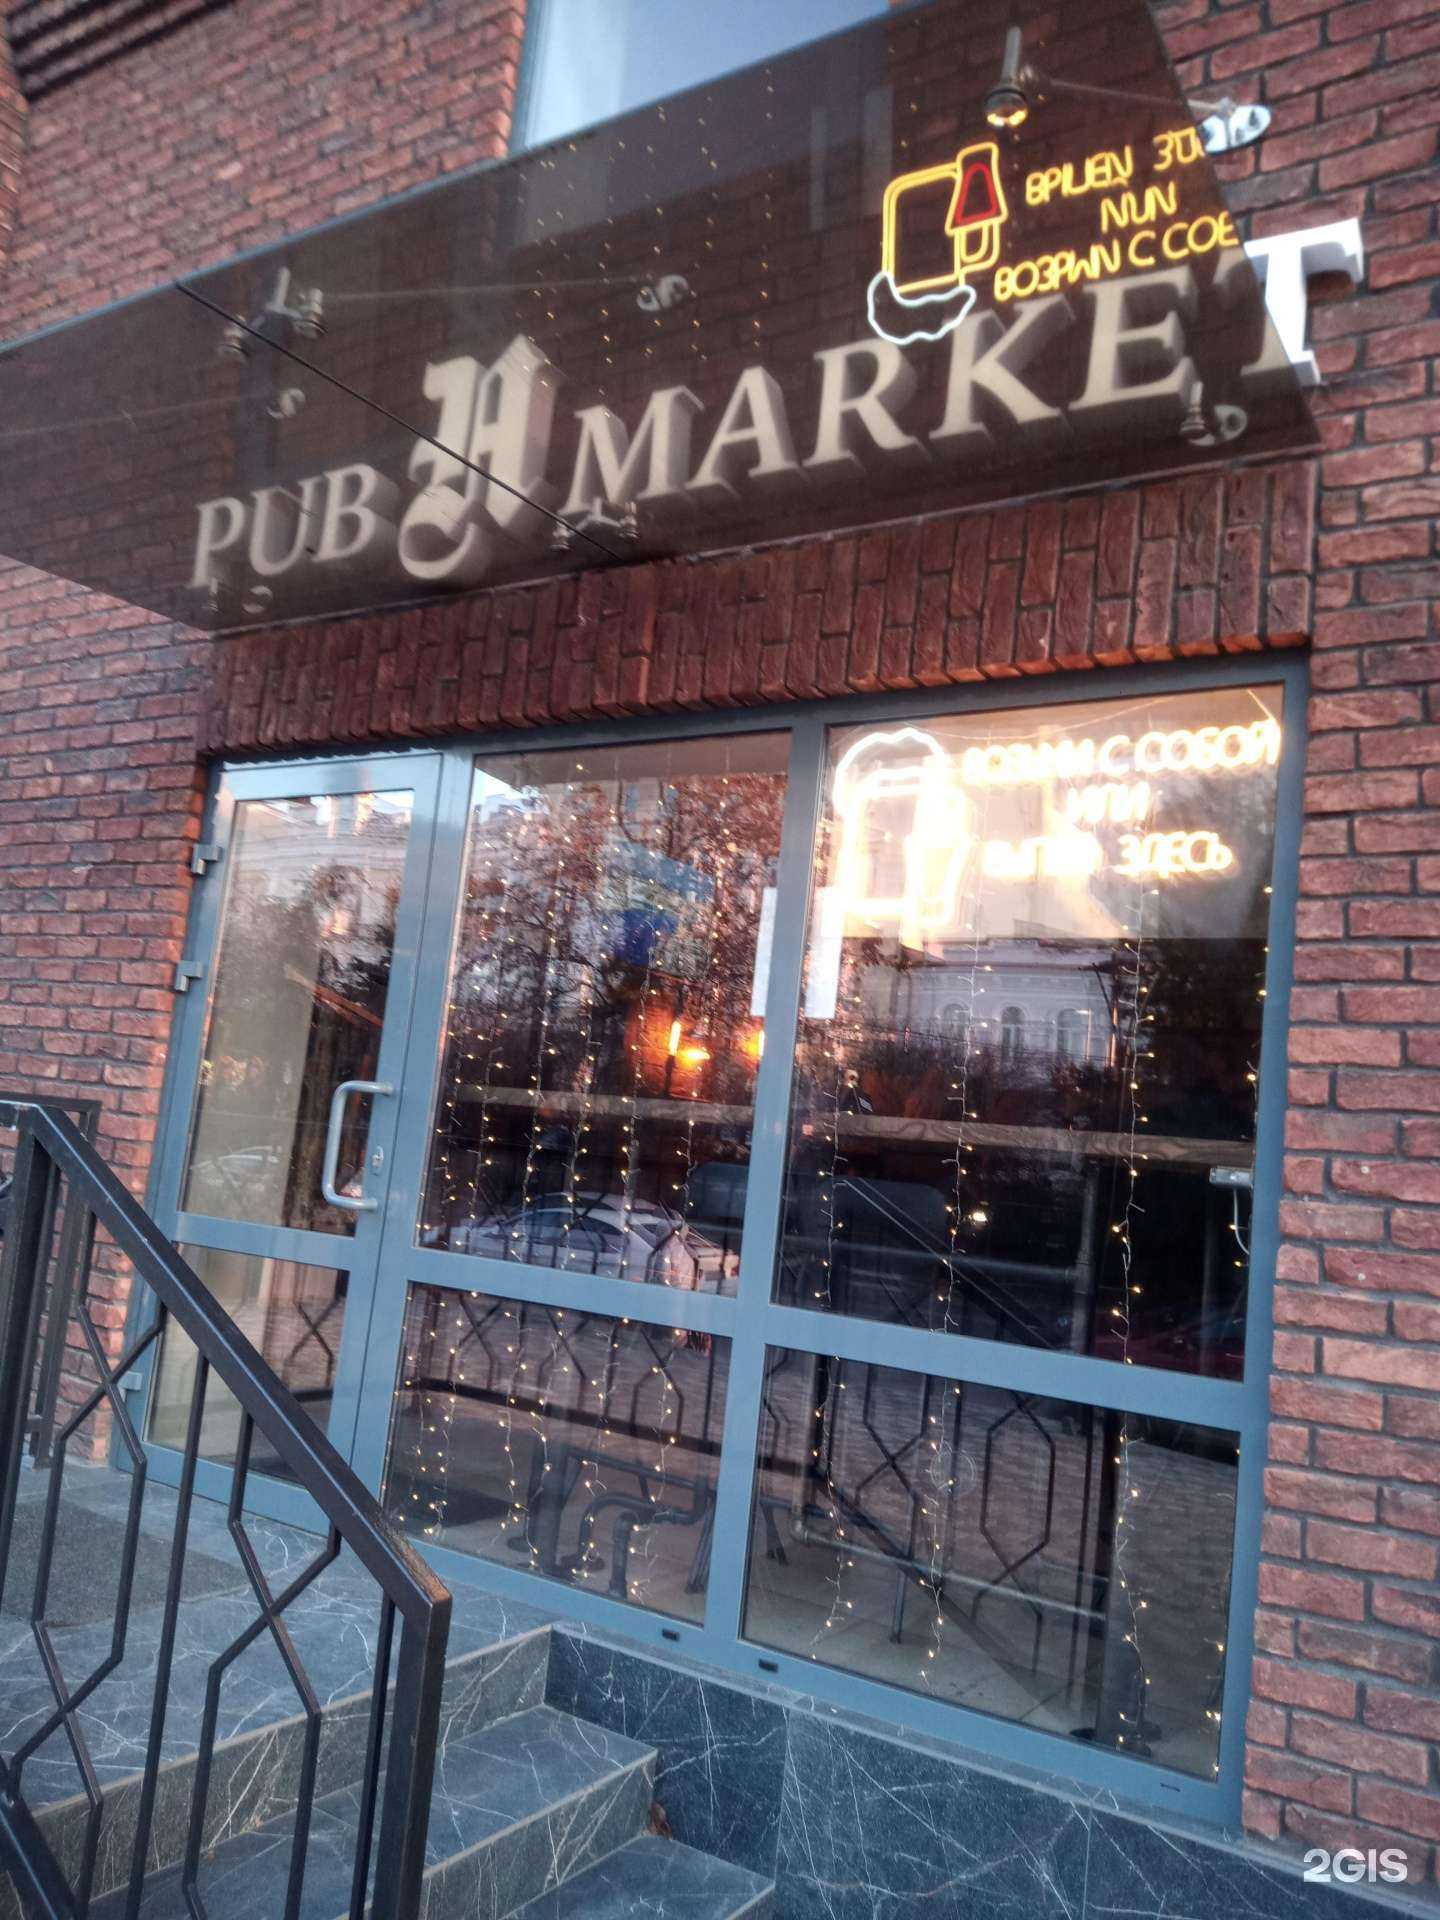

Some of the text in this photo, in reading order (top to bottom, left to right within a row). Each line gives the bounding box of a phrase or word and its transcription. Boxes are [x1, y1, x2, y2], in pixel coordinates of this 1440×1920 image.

[186, 462, 392, 590] PUB
[558, 218, 1366, 518] MARKET
[980, 835, 1102, 878] ВЫП
